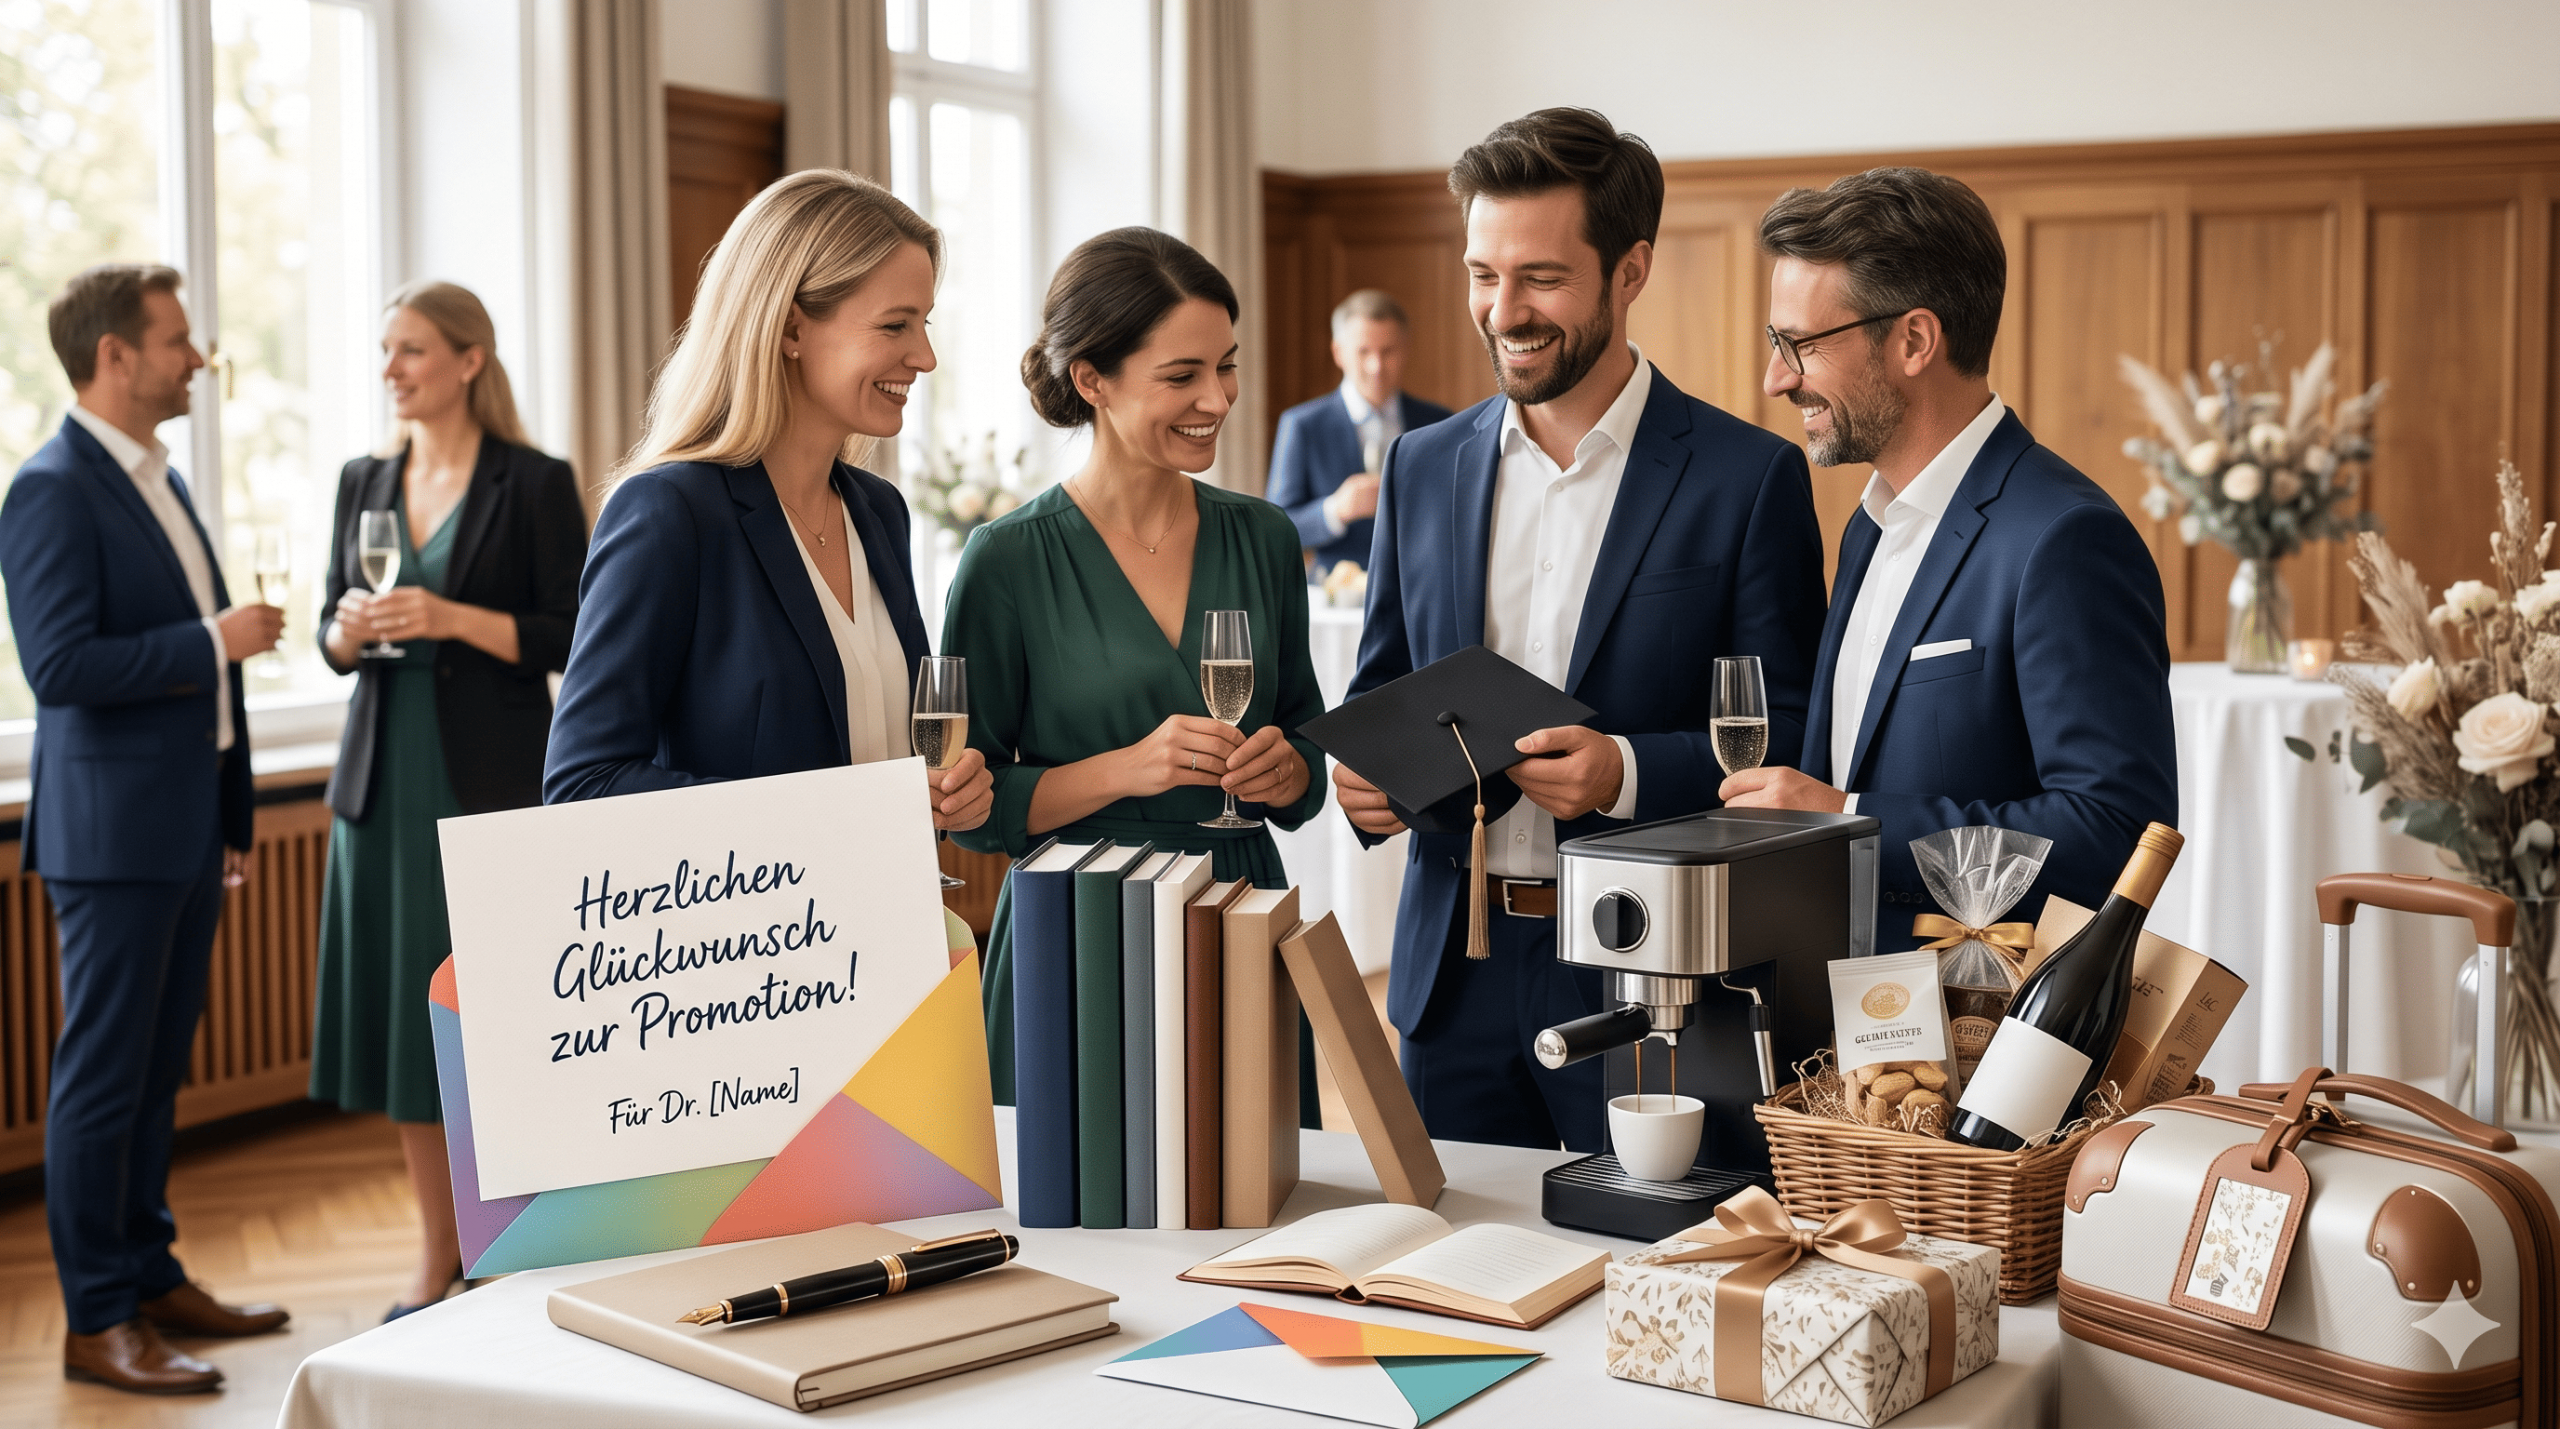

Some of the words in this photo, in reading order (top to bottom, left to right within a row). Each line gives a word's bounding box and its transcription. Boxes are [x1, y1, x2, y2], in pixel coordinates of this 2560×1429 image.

[574, 850, 806, 931] Herzlichen
[554, 898, 837, 1003] Glückwunsch
[551, 1024, 620, 1062] zur
[631, 951, 858, 1051] Promotion!
[608, 1098, 654, 1134] Für
[659, 1090, 701, 1123] Dr.
[711, 1067, 799, 1117] [Name]
